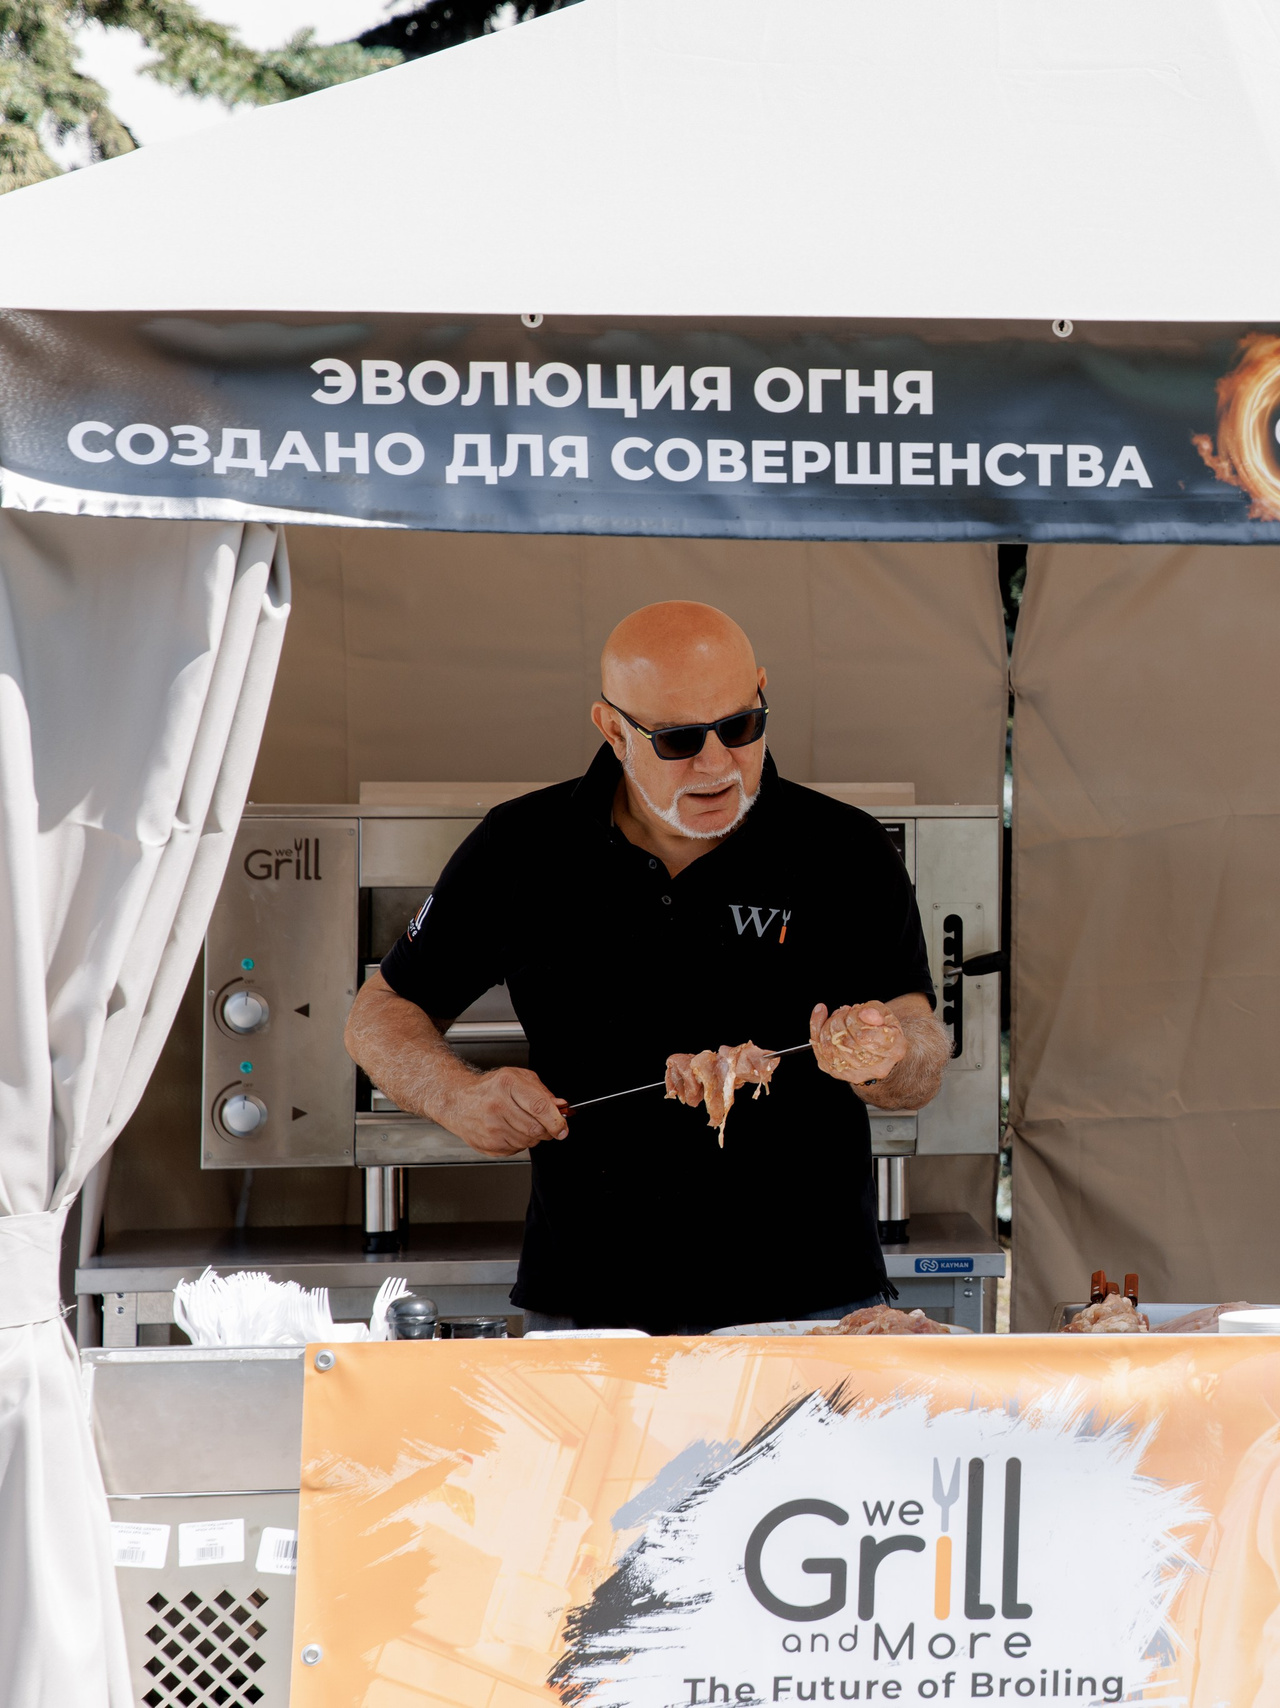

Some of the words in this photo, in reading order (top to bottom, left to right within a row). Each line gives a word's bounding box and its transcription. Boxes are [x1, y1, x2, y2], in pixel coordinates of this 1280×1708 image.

[310, 358, 731, 418] ЭВОЛЮЦИЯ
[753, 366, 933, 415] ОГНЯ
[67, 420, 425, 478] СОЗДАНО
[445, 433, 589, 485] ДЛЯ
[610, 436, 1153, 488] СОВЕРШЕНСТВА
[244, 838, 322, 881] Grill
[275, 849, 293, 857] we
[862, 1500, 924, 1526] we
[744, 1456, 1033, 1622] Grill
[782, 1624, 859, 1653] and
[872, 1622, 1032, 1661] More
[683, 1677, 756, 1703] The
[772, 1675, 902, 1701] Future
[917, 1671, 956, 1699] of
[970, 1668, 1124, 1702] Broiling
